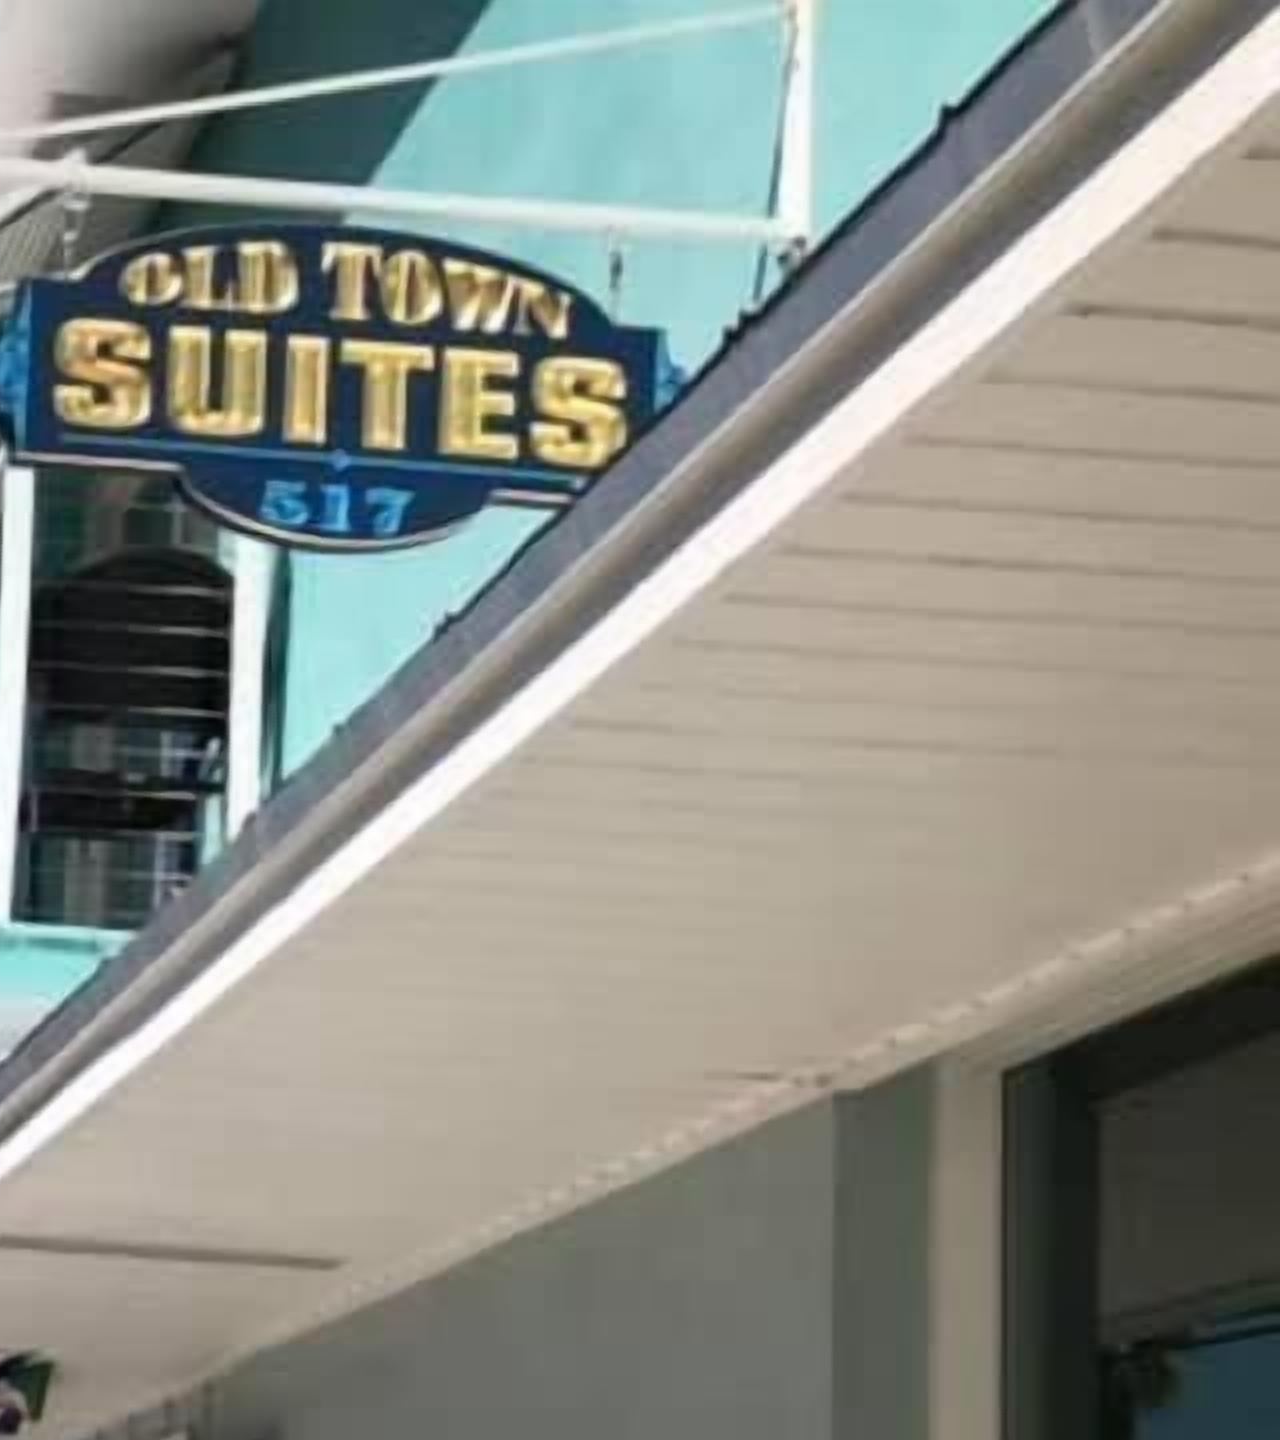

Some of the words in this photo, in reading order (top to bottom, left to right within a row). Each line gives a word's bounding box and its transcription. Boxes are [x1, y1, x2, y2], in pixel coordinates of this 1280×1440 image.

[119, 238, 299, 315] OLD
[321, 240, 571, 339] TOWN
[52, 316, 629, 469] SUITES
[260, 479, 415, 535] 517
